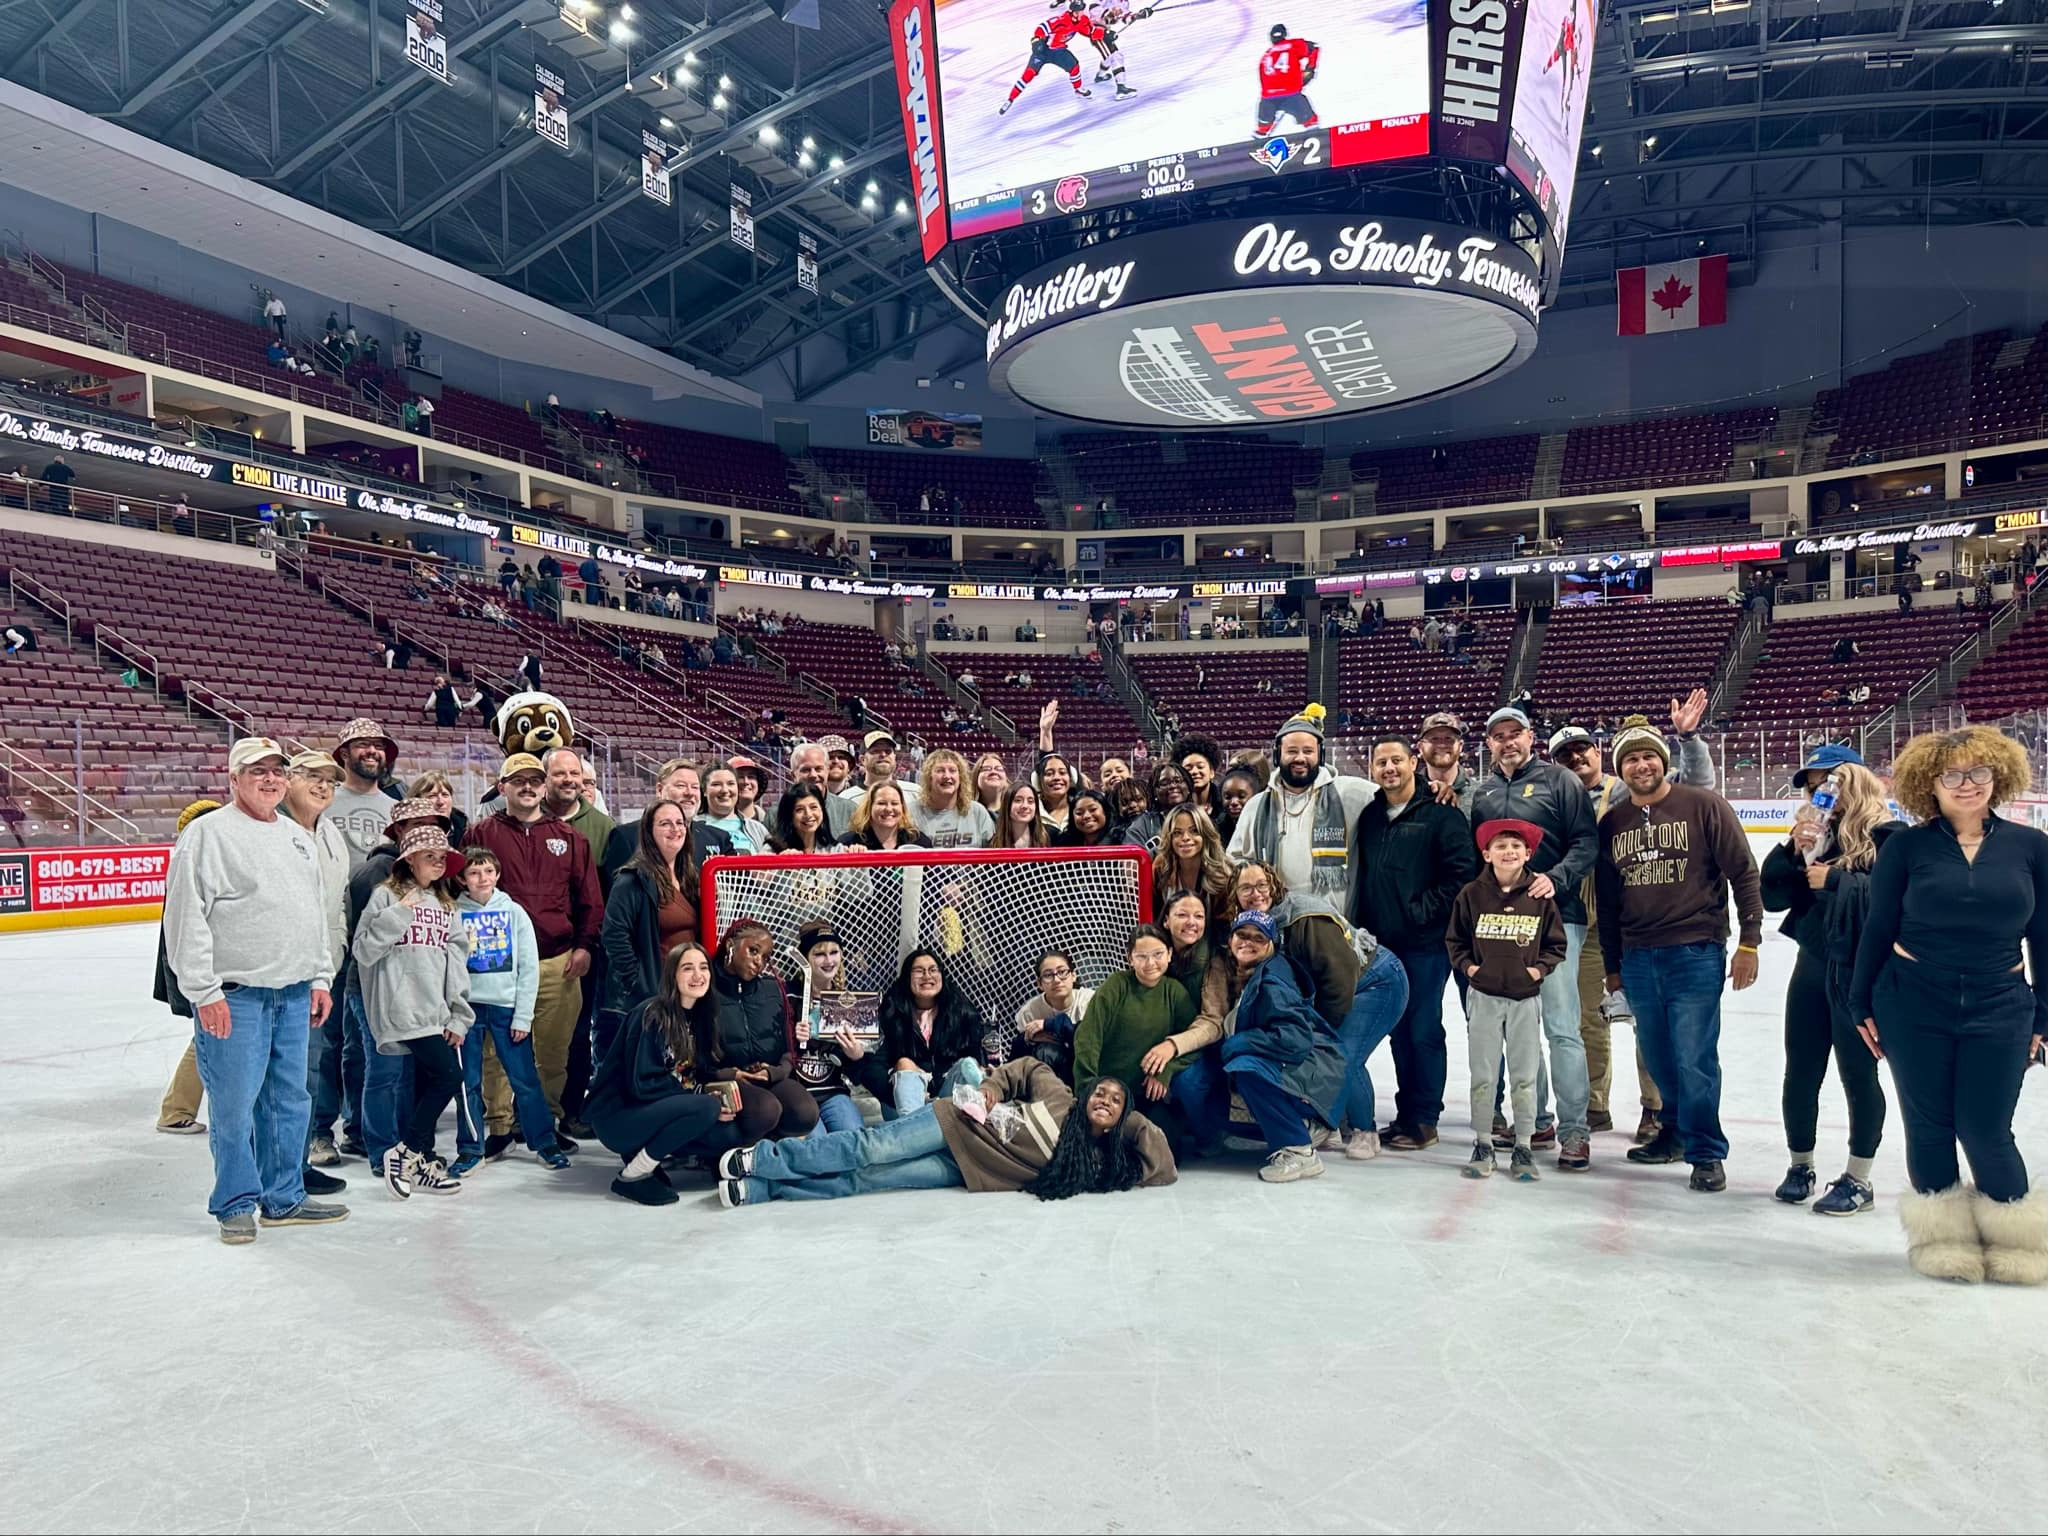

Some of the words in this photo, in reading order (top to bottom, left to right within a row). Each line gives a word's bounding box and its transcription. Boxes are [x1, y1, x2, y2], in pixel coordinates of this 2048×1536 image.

[410, 36, 444, 73] 2006
[1264, 51, 1290, 76] 14
[537, 112, 566, 142] 2009
[1338, 122, 1371, 135] PLAYER
[1382, 115, 1421, 128] PENALTY
[1148, 155, 1177, 168] PERIOD
[1177, 153, 1184, 163] 3
[1212, 148, 1218, 156] 0
[1303, 137, 1321, 165] 2
[1133, 163, 1137, 171] 1
[1147, 164, 1186, 186] 00.0
[645, 174, 667, 198] 2010
[1141, 188, 1153, 199] 30
[1155, 184, 1181, 195] SHOTS
[1181, 180, 1194, 192] 25
[954, 199, 980, 211] PLAYER
[986, 190, 1016, 203] PENALTY
[1031, 190, 1046, 214] 3
[732, 222, 752, 246] 2023
[1330, 223, 1452, 286] Smoky
[1003, 261, 1136, 340] Distillery
[1192, 322, 1337, 416] GIANT
[1304, 319, 1398, 399] CENTER
[116, 392, 141, 402] GIANT
[869, 415, 900, 430] Real
[869, 429, 903, 443] Deal
[29, 421, 80, 450] Smoky
[80, 432, 145, 462] Tennessee
[148, 446, 213, 478] Distillery
[232, 463, 271, 487] C'MON
[273, 471, 299, 492] LIVE
[300, 478, 309, 495] A
[310, 480, 347, 500] LITTLE
[412, 504, 455, 527] Tennessee
[455, 512, 500, 538] Distillery
[1995, 511, 2037, 529] C'MON
[512, 525, 539, 545] C'MON
[539, 531, 558, 548] LIVE
[558, 535, 566, 550] A
[566, 537, 590, 555] LITTLE
[1857, 530, 1912, 547] Tennessee
[1913, 522, 1977, 541] Distillery
[1469, 568, 1480, 580] 3
[1496, 565, 1529, 575] PERIOD
[1532, 563, 1541, 573] 3
[1548, 560, 1576, 572] 00.0
[1587, 558, 1599, 571] 2
[1636, 559, 1650, 568] 25
[719, 566, 747, 581] C'MON
[748, 569, 766, 582] LIVE
[768, 570, 775, 584] A
[776, 572, 803, 586] LITTLE
[1427, 576, 1441, 584] 30
[948, 585, 976, 596] C'MON
[978, 585, 997, 596] LIVE
[999, 586, 1006, 597] A
[1007, 586, 1035, 598] LITTLE
[1192, 584, 1223, 595] C'MON
[1224, 583, 1244, 594] LIVE
[1246, 582, 1254, 593] A
[1255, 581, 1286, 593] LITTLE
[1612, 820, 1689, 863] MILTON
[38, 856, 164, 879] 800-679-BEST
[39, 880, 165, 904] BESTLINE.COM
[414, 906, 454, 929] RSHE
[1479, 913, 1541, 926] HERSHEY
[1475, 922, 1539, 937] BEARS
[802, 1063, 828, 1077] BEARS
